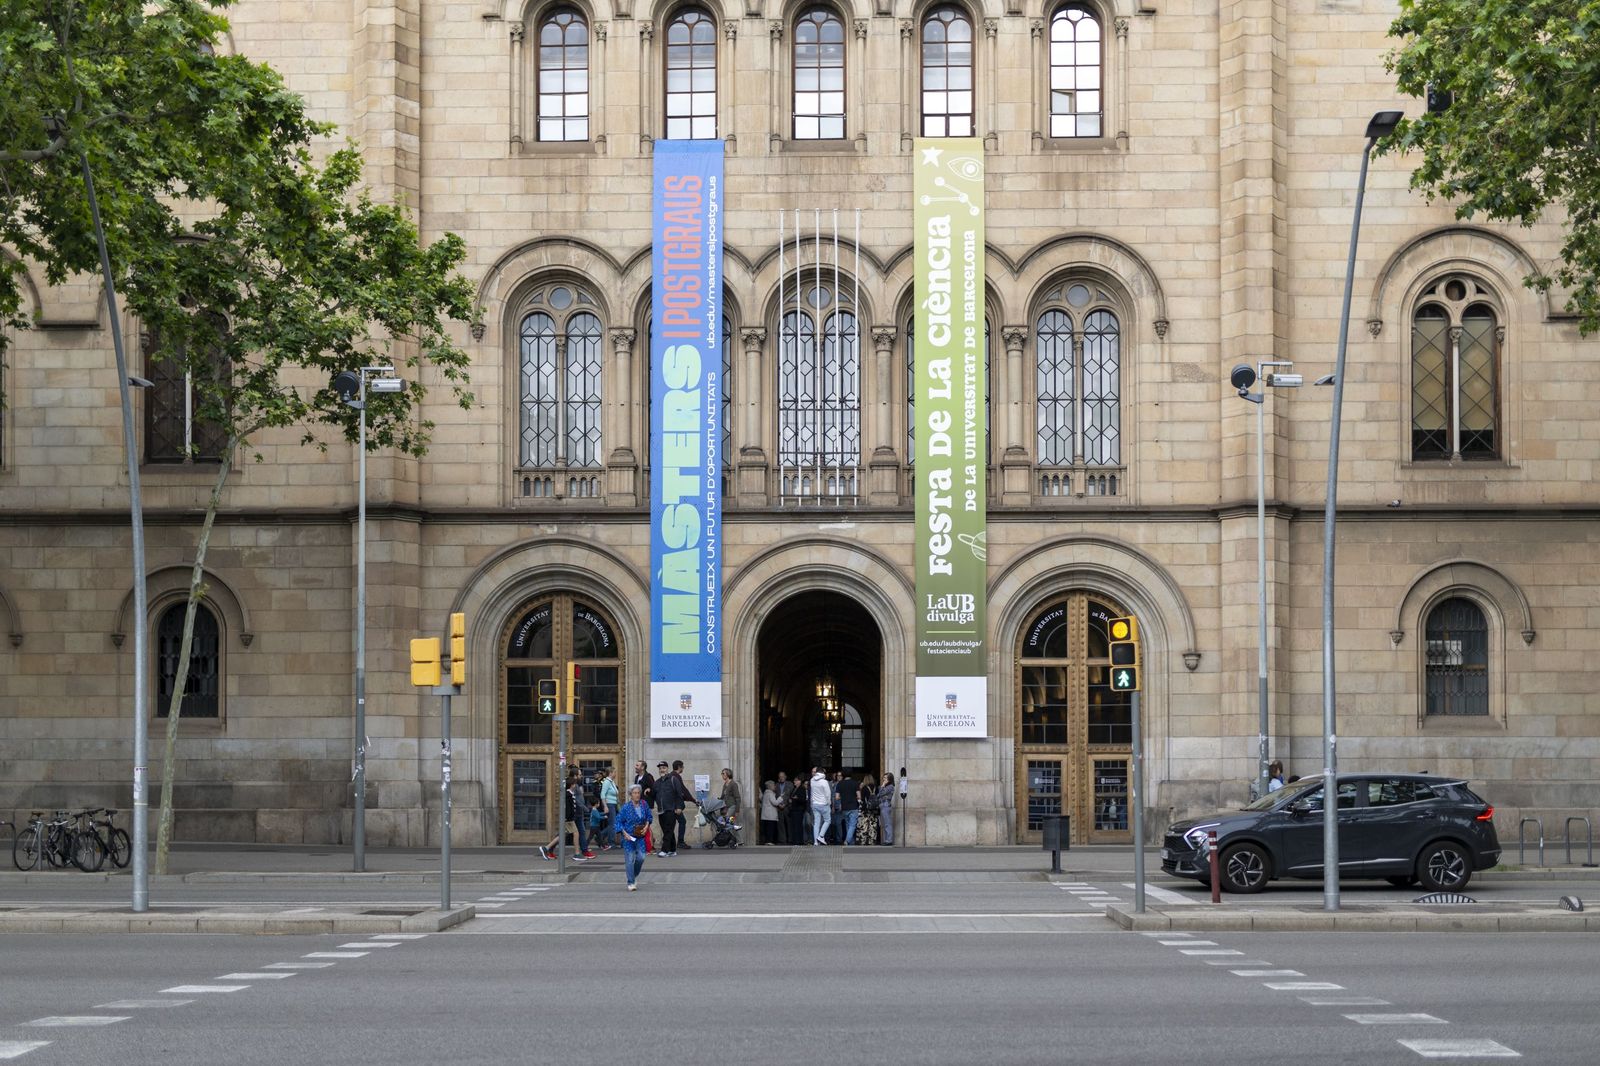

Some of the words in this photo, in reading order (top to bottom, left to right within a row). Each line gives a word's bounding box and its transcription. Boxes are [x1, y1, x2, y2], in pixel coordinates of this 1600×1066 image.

[662, 175, 702, 325] POSTGRAUS
[706, 175, 718, 349] ub.edu/mastersipostgraus
[657, 344, 702, 654] MÀSTERS
[706, 491, 716, 536] FUTUR
[706, 539, 716, 559] UN
[706, 561, 716, 654] CONSTRUEIX
[926, 594, 975, 612] LaUB
[926, 610, 975, 624] divulga
[661, 720, 711, 728] BARCELONA
